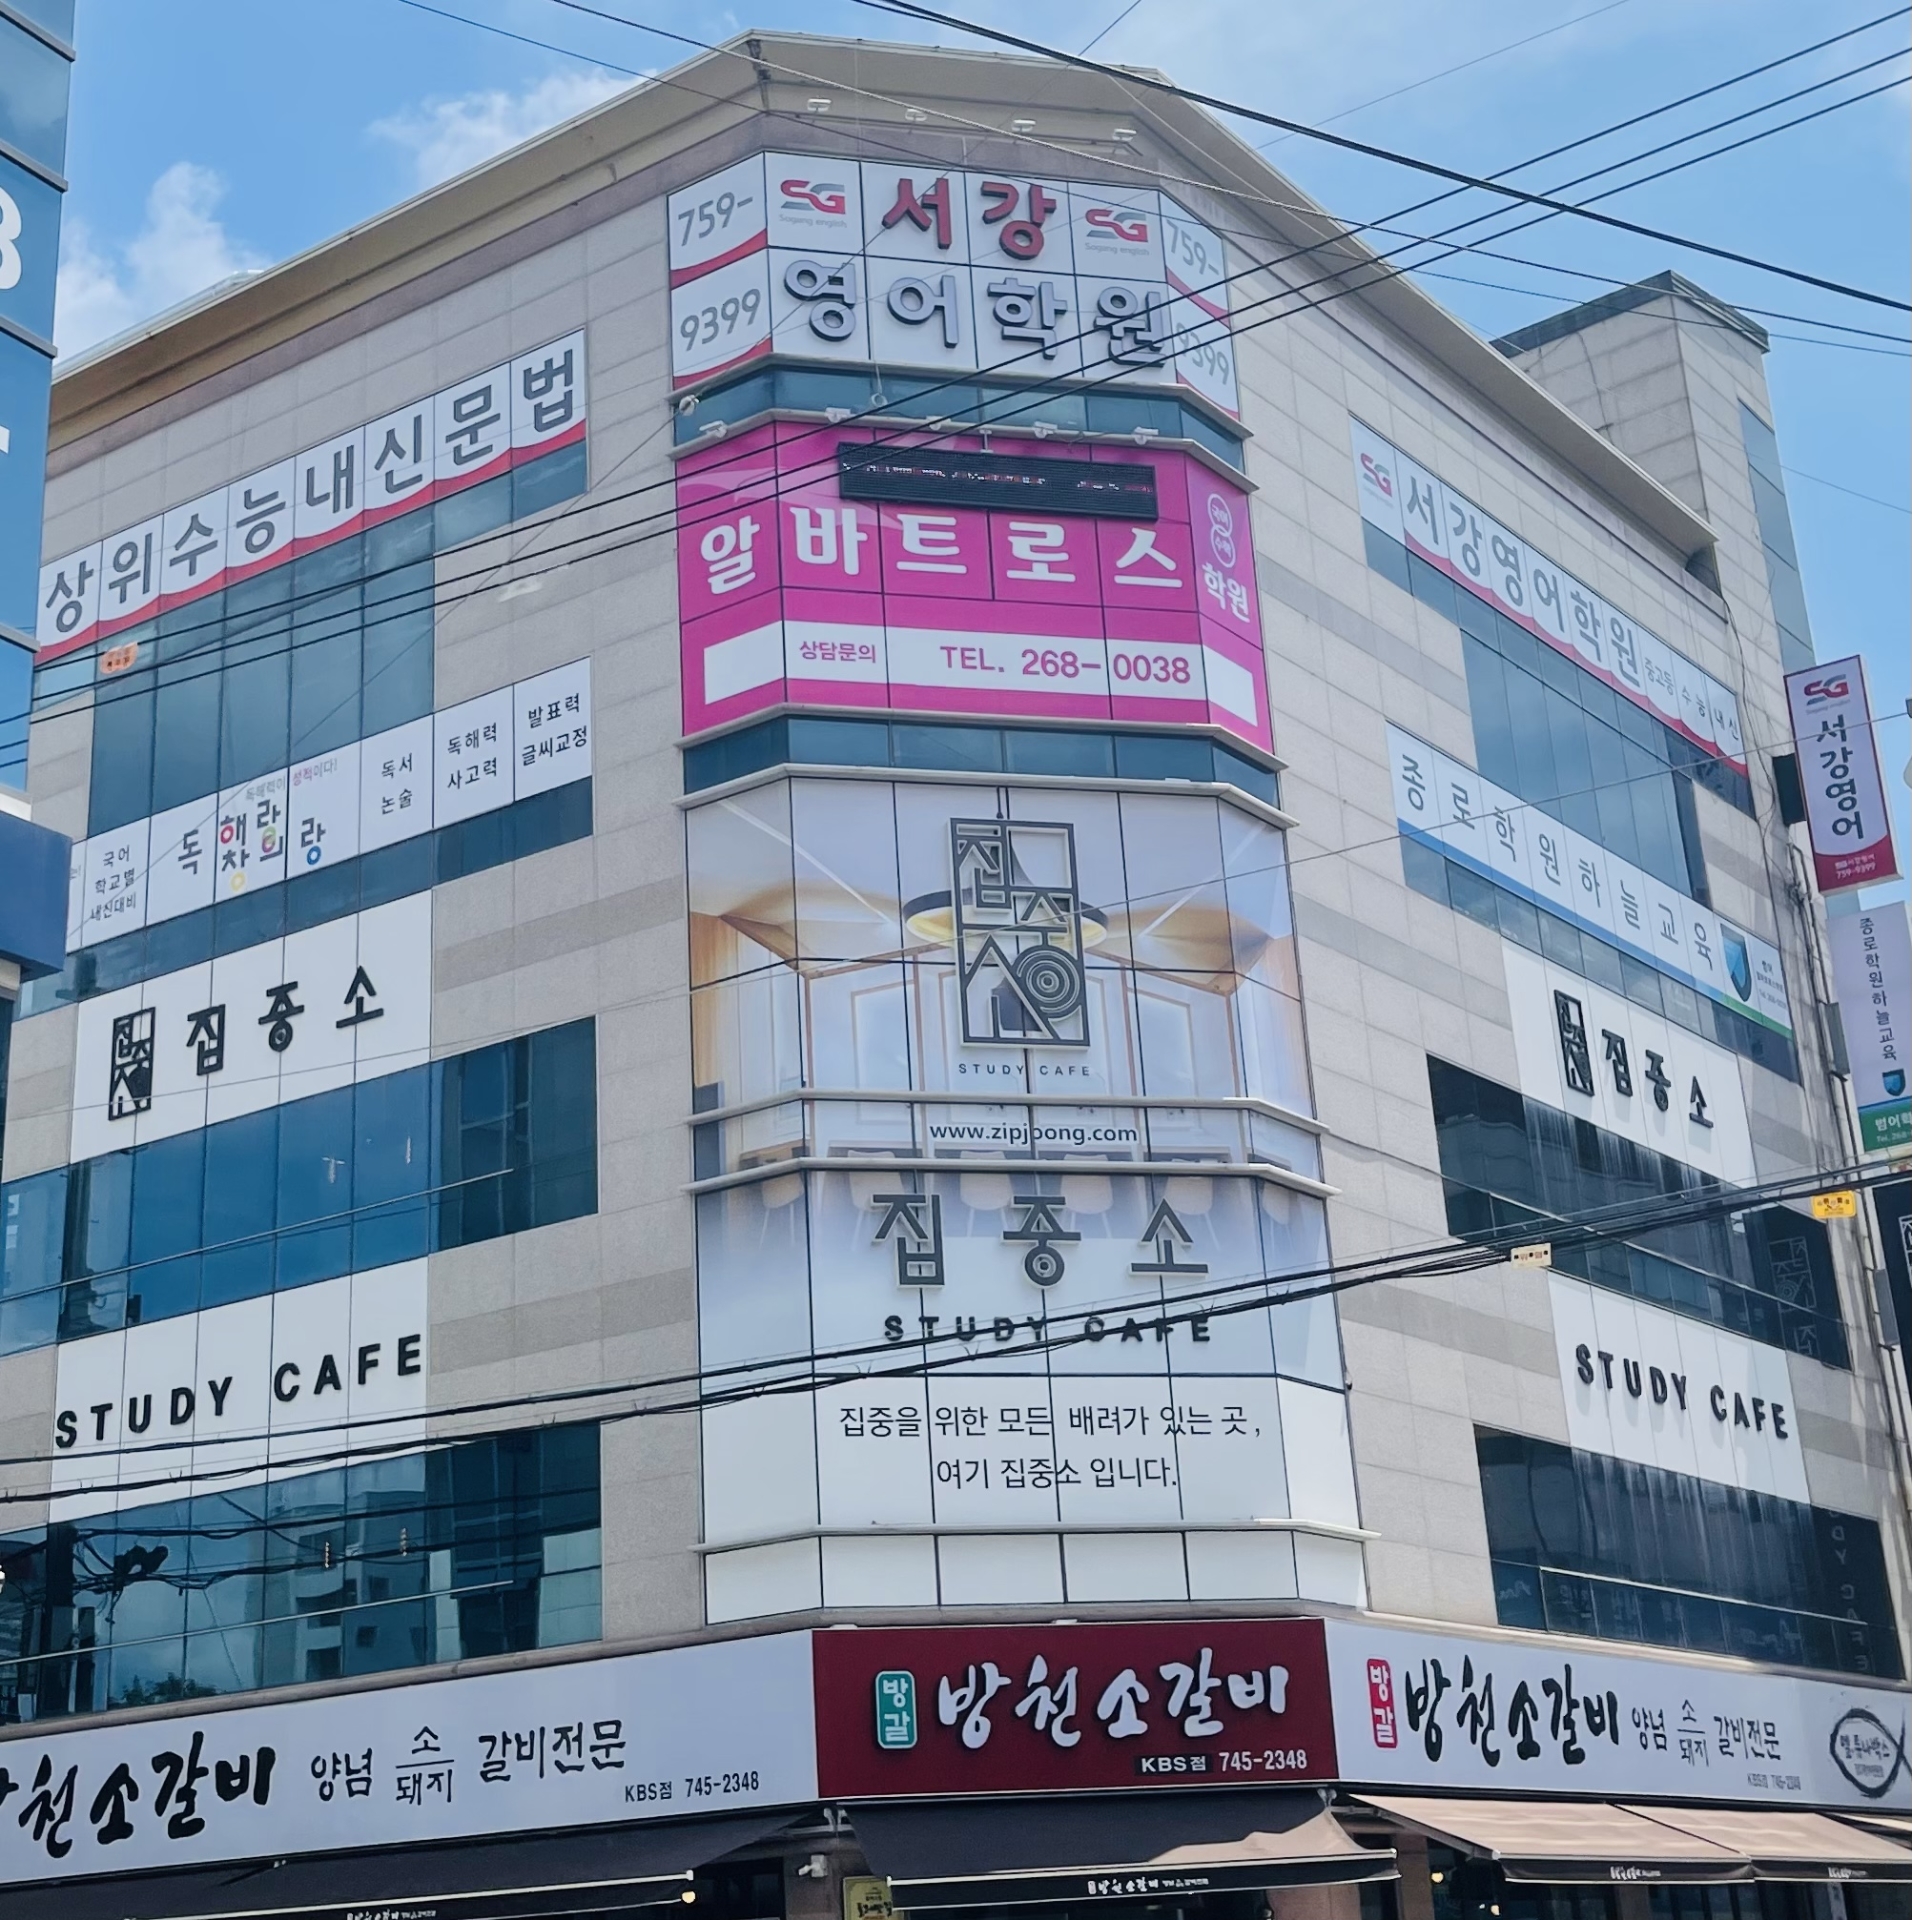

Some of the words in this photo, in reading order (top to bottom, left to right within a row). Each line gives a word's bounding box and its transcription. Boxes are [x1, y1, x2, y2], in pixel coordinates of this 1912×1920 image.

[678, 192, 753, 246] 759-
[882, 177, 1056, 260] 서강
[1167, 219, 1219, 275] 759-
[680, 289, 760, 351] 9399
[784, 260, 1165, 367] 영어학원
[1176, 322, 1230, 385] 9399
[46, 348, 573, 634] 상위수능내신문법
[701, 506, 1183, 594] 알바트로스
[1201, 561, 1250, 623] 학원
[1407, 475, 1640, 688] 서강영어학원
[799, 639, 876, 664] 상담문의
[940, 645, 1005, 673] TEL.
[448, 722, 497, 755] 독해력
[528, 693, 580, 729] 발표력
[381, 752, 413, 779] 독서
[448, 757, 497, 790] 사고력
[522, 725, 588, 767] 글씨교정
[381, 788, 413, 815] 논술
[1816, 714, 1864, 839] 서강영어
[103, 844, 130, 867] 국어
[1402, 754, 1713, 970] 종로학원하늘교육
[1860, 917, 1897, 1062] 종로학원하늘교육
[187, 965, 385, 1076] 집중소
[958, 1063, 1025, 1077] STUDY
[1040, 1064, 1091, 1077] CAFE
[1602, 1029, 1714, 1129] 집중소
[929, 1120, 1139, 1147] www.zipjoong.com
[872, 1194, 1209, 1287] 집중소
[884, 1315, 1046, 1342] STUDY
[1085, 1315, 1211, 1343] CAFE
[55, 1375, 233, 1448] STUDY
[274, 1334, 421, 1401] CAFE
[1575, 1344, 1687, 1410] STUDY
[1710, 1385, 1788, 1439] CAFE
[839, 1406, 922, 1438] 집중을
[934, 1406, 988, 1437] 위한
[997, 1407, 1053, 1437] 모든
[1069, 1406, 1149, 1437] 배려가
[1160, 1406, 1213, 1437] 있는
[936, 1458, 990, 1490] 여기
[1000, 1458, 1082, 1488] 집중소
[1090, 1457, 1178, 1488] 입니다.
[881, 1678, 910, 1743] 방갈
[937, 1647, 1289, 1749] 방천소갈비
[1370, 1664, 1395, 1744] 방갈
[1405, 1654, 1619, 1767] 방천소갈비
[1632, 1707, 1667, 1751] 양념
[1682, 1699, 1698, 1723] 소
[411, 1725, 441, 1755] 소
[478, 1719, 626, 1783] 갈비전문
[1140, 1756, 1207, 1774] KBS점
[1218, 1749, 1307, 1772] 745-2348
[1679, 1738, 1710, 1768] 돼지
[1713, 1715, 1782, 1761] 갈비전문
[311, 1747, 373, 1802] 양념
[396, 1768, 453, 1805] 돼지
[625, 1780, 673, 1803] KBS점
[685, 1771, 759, 1799] 745-2348
